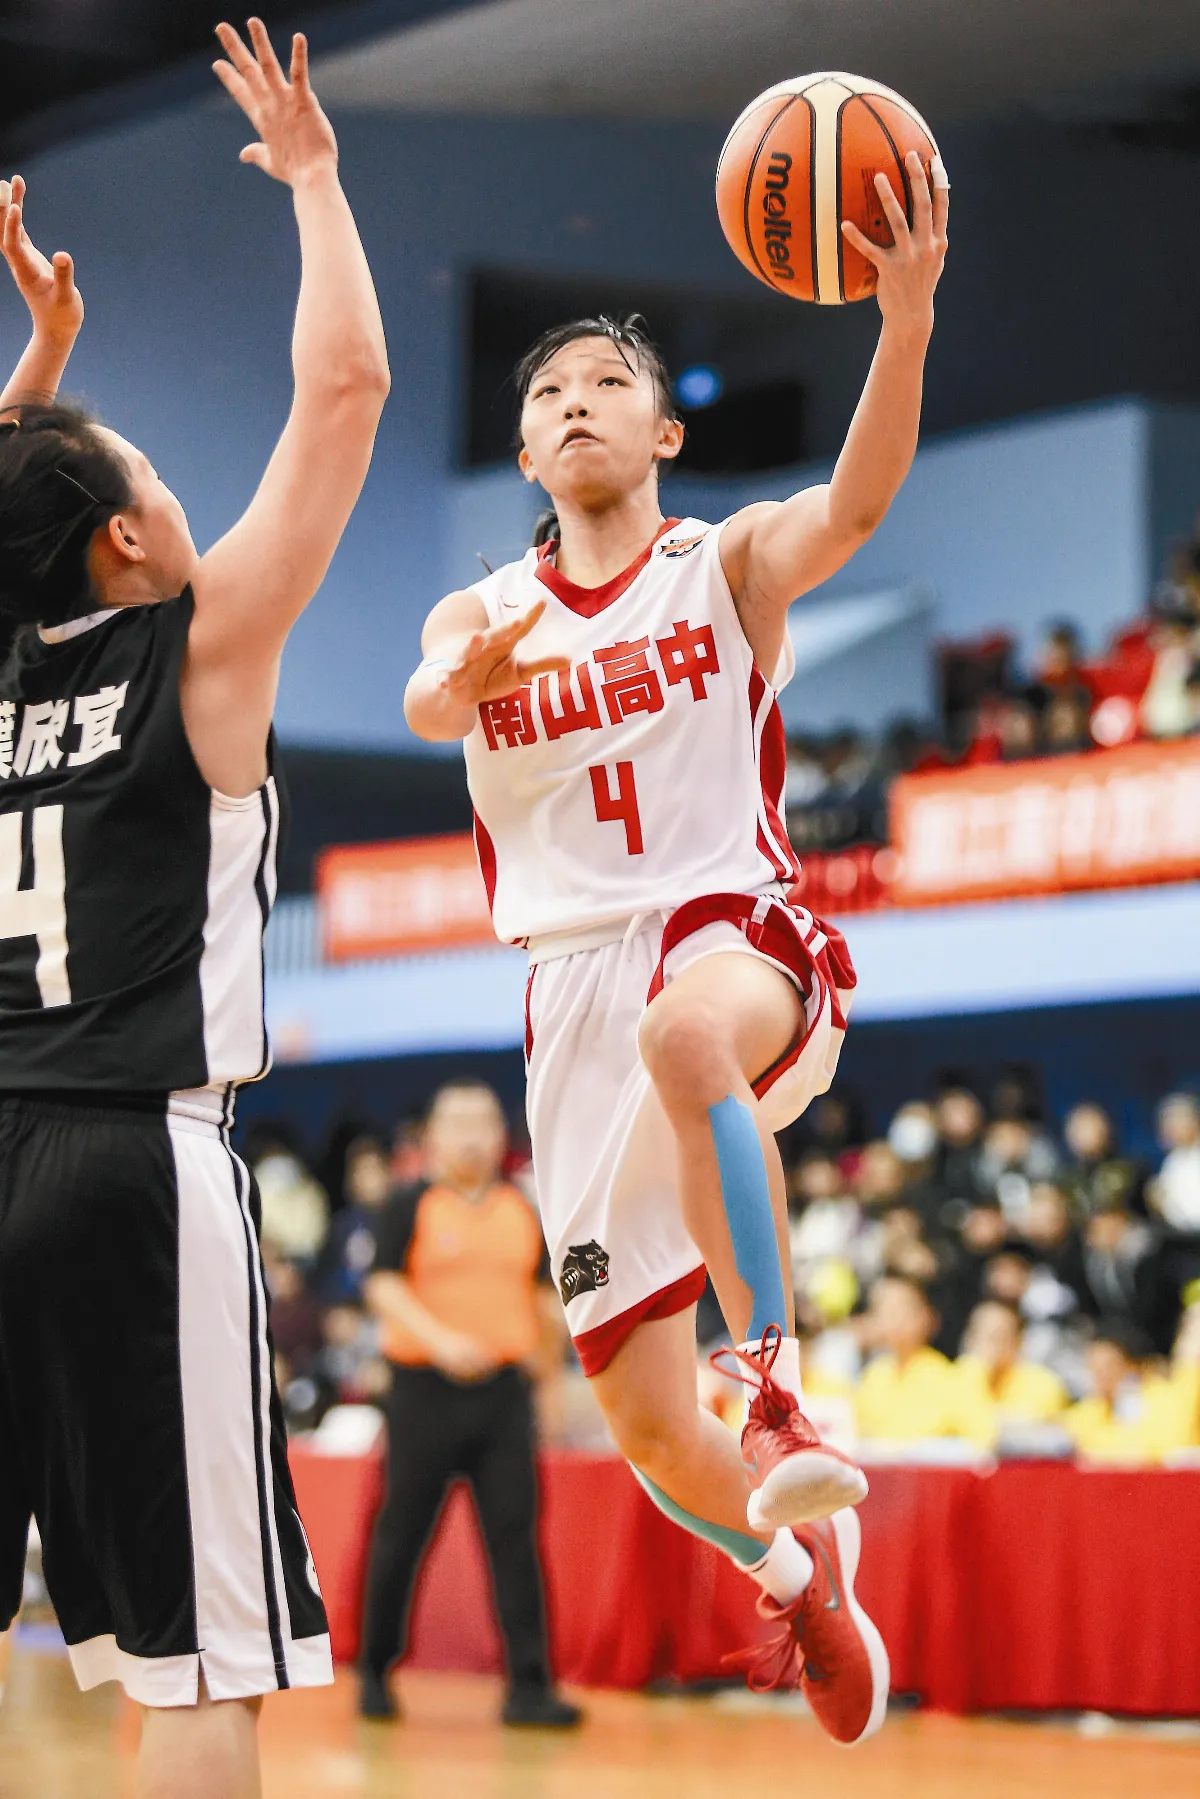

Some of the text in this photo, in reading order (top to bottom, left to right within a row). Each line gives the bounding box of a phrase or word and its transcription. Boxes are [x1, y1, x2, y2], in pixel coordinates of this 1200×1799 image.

[763, 152, 795, 280] molten
[479, 619, 721, 752] 南山高中
[588, 760, 645, 856] 4
[0, 804, 72, 1009] 4
